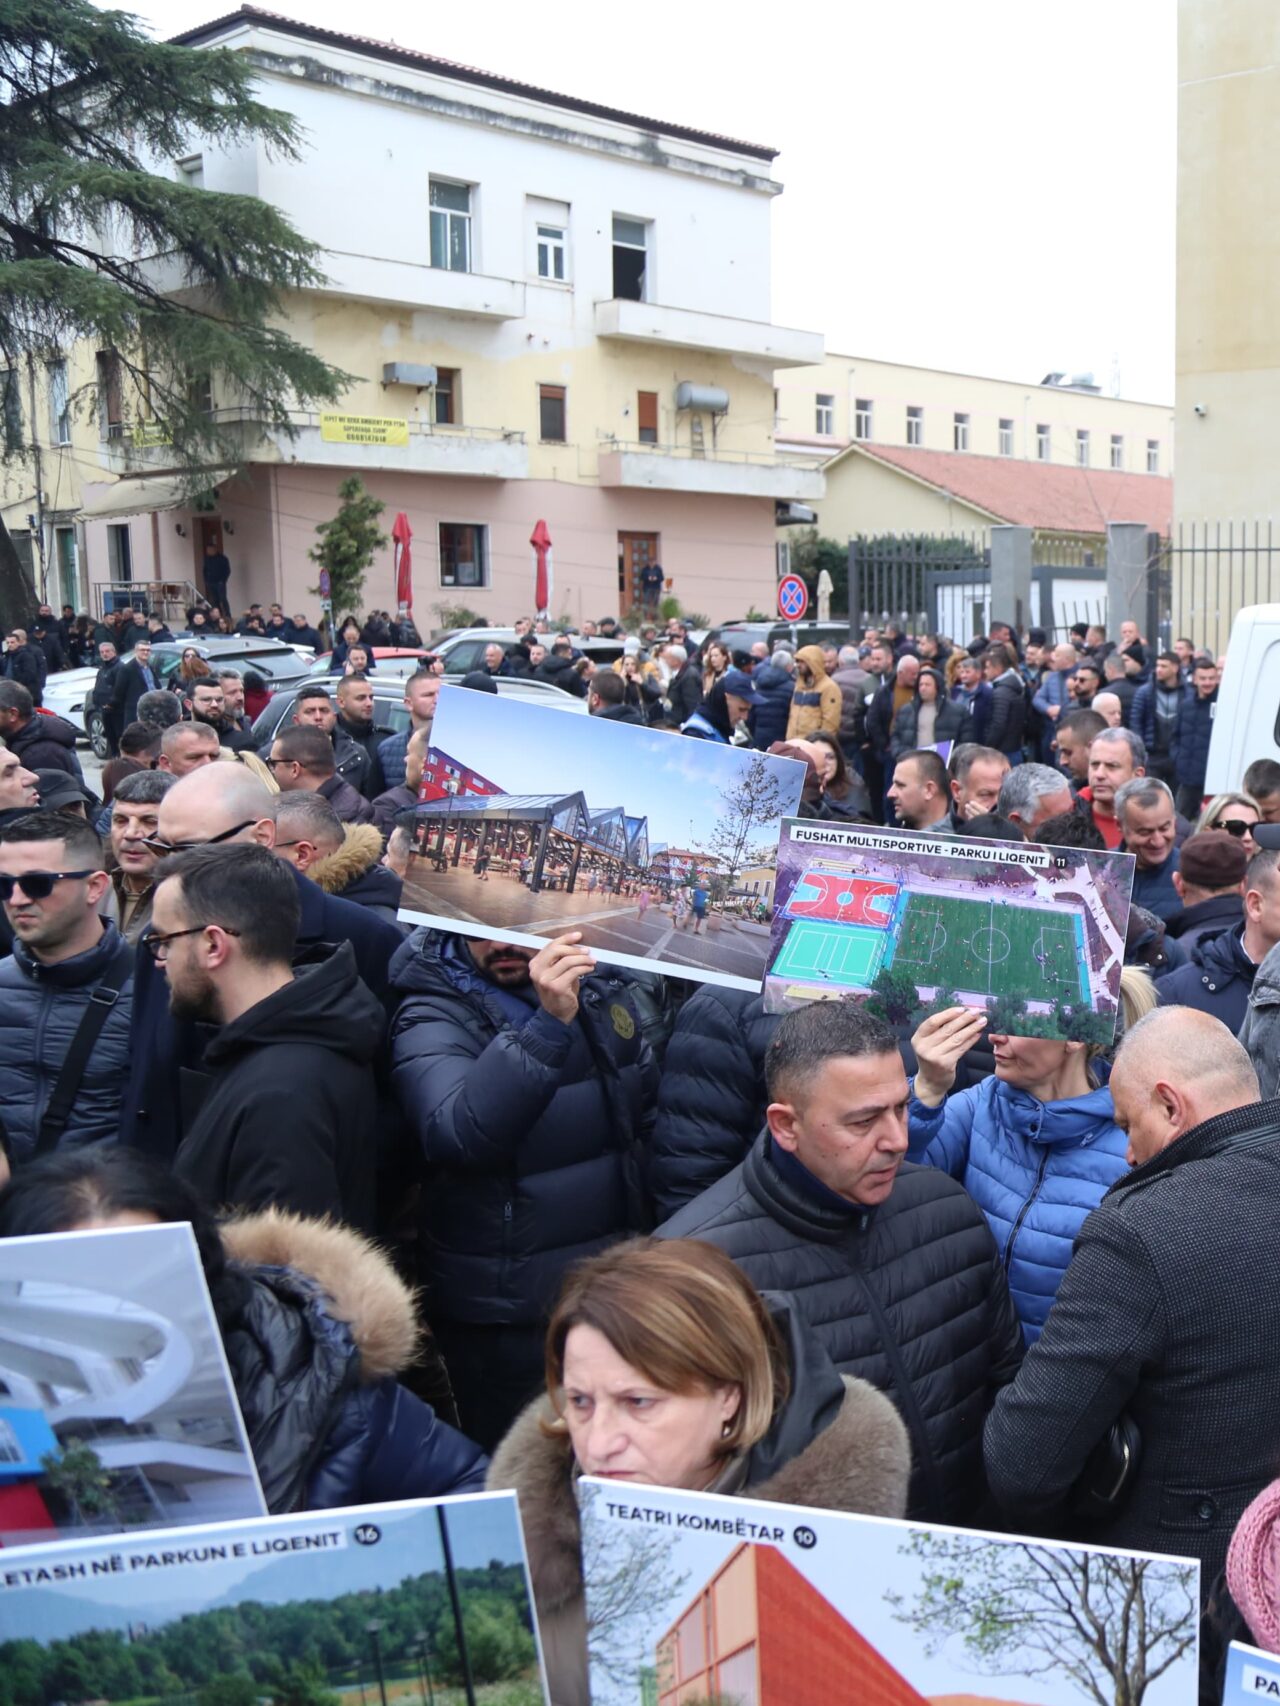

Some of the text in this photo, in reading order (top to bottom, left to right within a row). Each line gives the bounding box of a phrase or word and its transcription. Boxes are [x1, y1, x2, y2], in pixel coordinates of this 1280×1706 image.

[796, 829, 845, 844] FUSHAT
[846, 835, 942, 855] MULTISPORTIVE
[951, 847, 990, 861] PARKU
[1000, 852, 1046, 866] LIQENIT
[606, 1502, 813, 1545] TEATRI KOMBËTAR 10
[91, 1555, 126, 1576] NË
[130, 1548, 226, 1571] PARKUN
[233, 1543, 249, 1558] E
[251, 1530, 342, 1556] LIQENIT
[356, 1526, 378, 1543] 16
